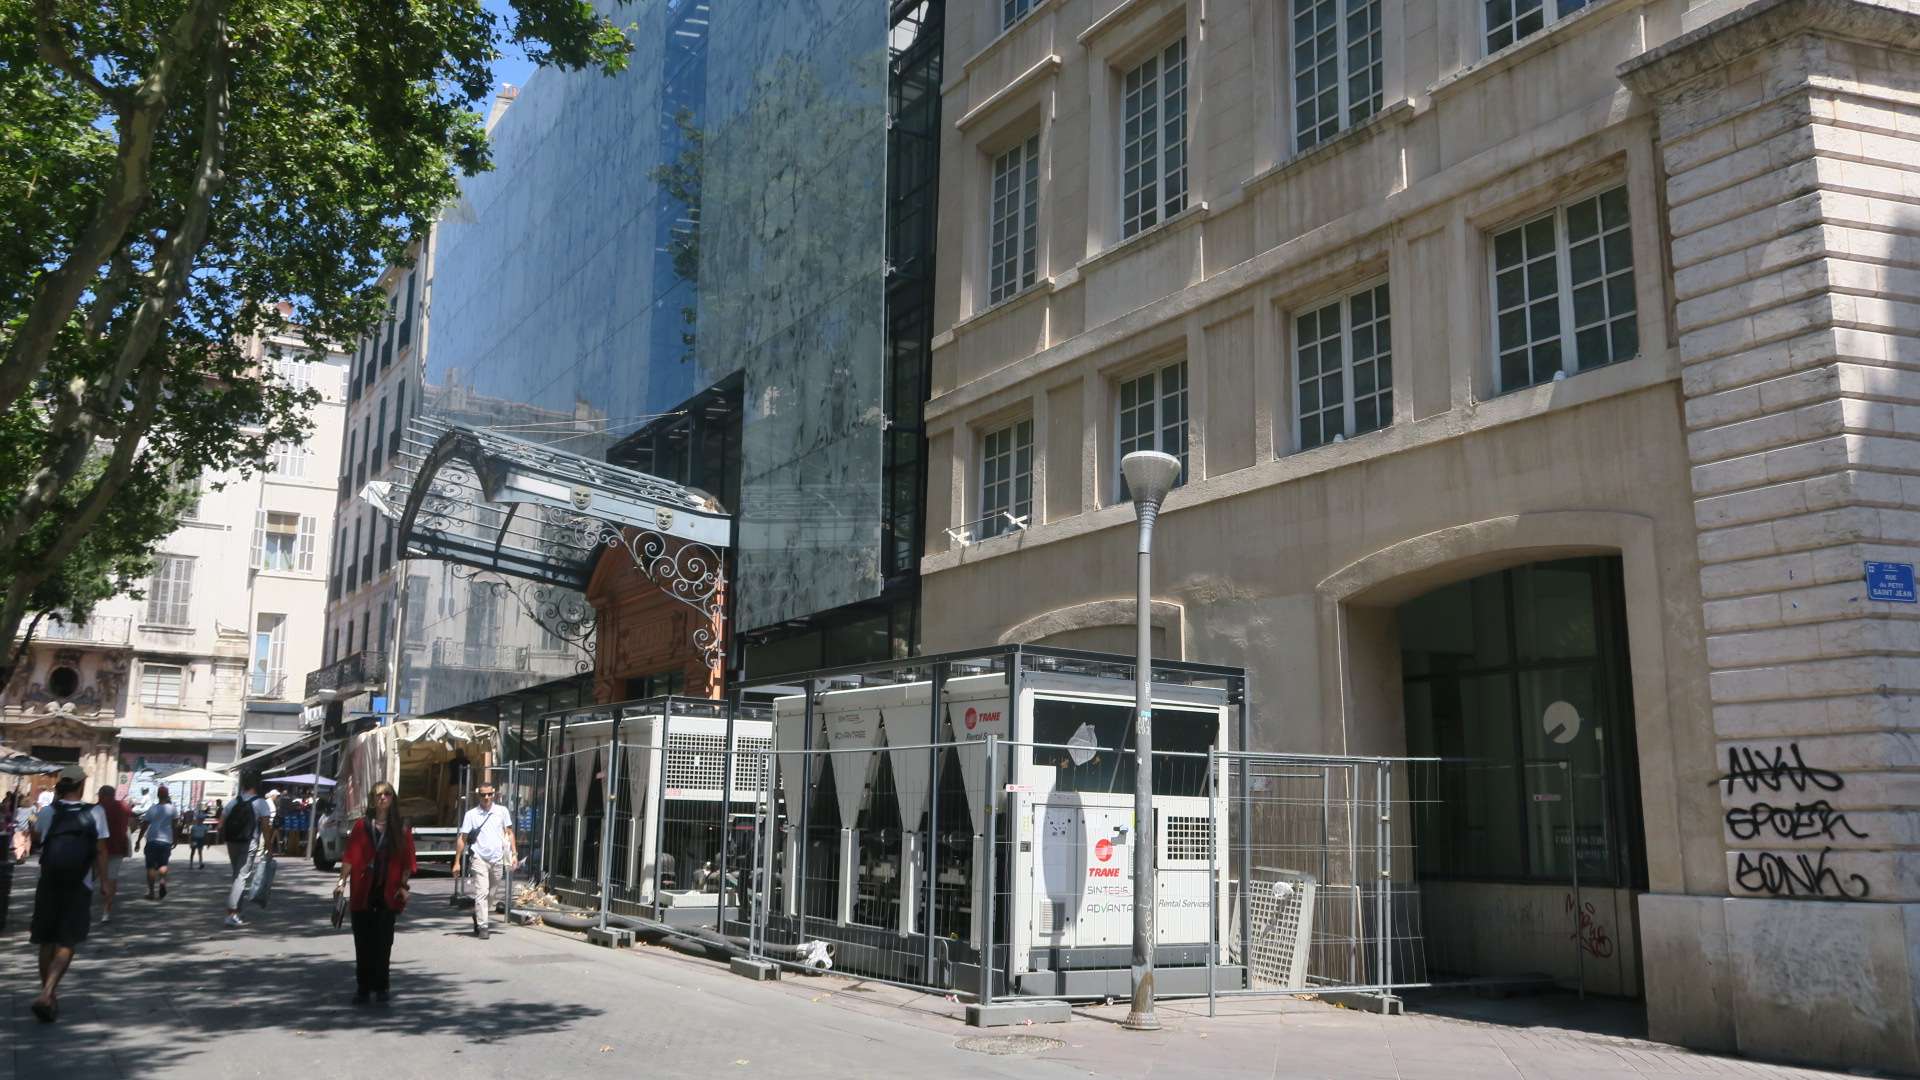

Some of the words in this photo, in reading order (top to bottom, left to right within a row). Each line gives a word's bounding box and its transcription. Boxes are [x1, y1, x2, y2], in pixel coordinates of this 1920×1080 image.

[1872, 588, 1894, 596] SAINT
[978, 711, 1001, 723] TRANE
[834, 730, 867, 740] ADVANTAGE
[966, 732, 983, 741] Rental
[1088, 867, 1121, 877] TRANE
[1087, 902, 1133, 913] ADVANTA
[1182, 899, 1210, 907] Services
